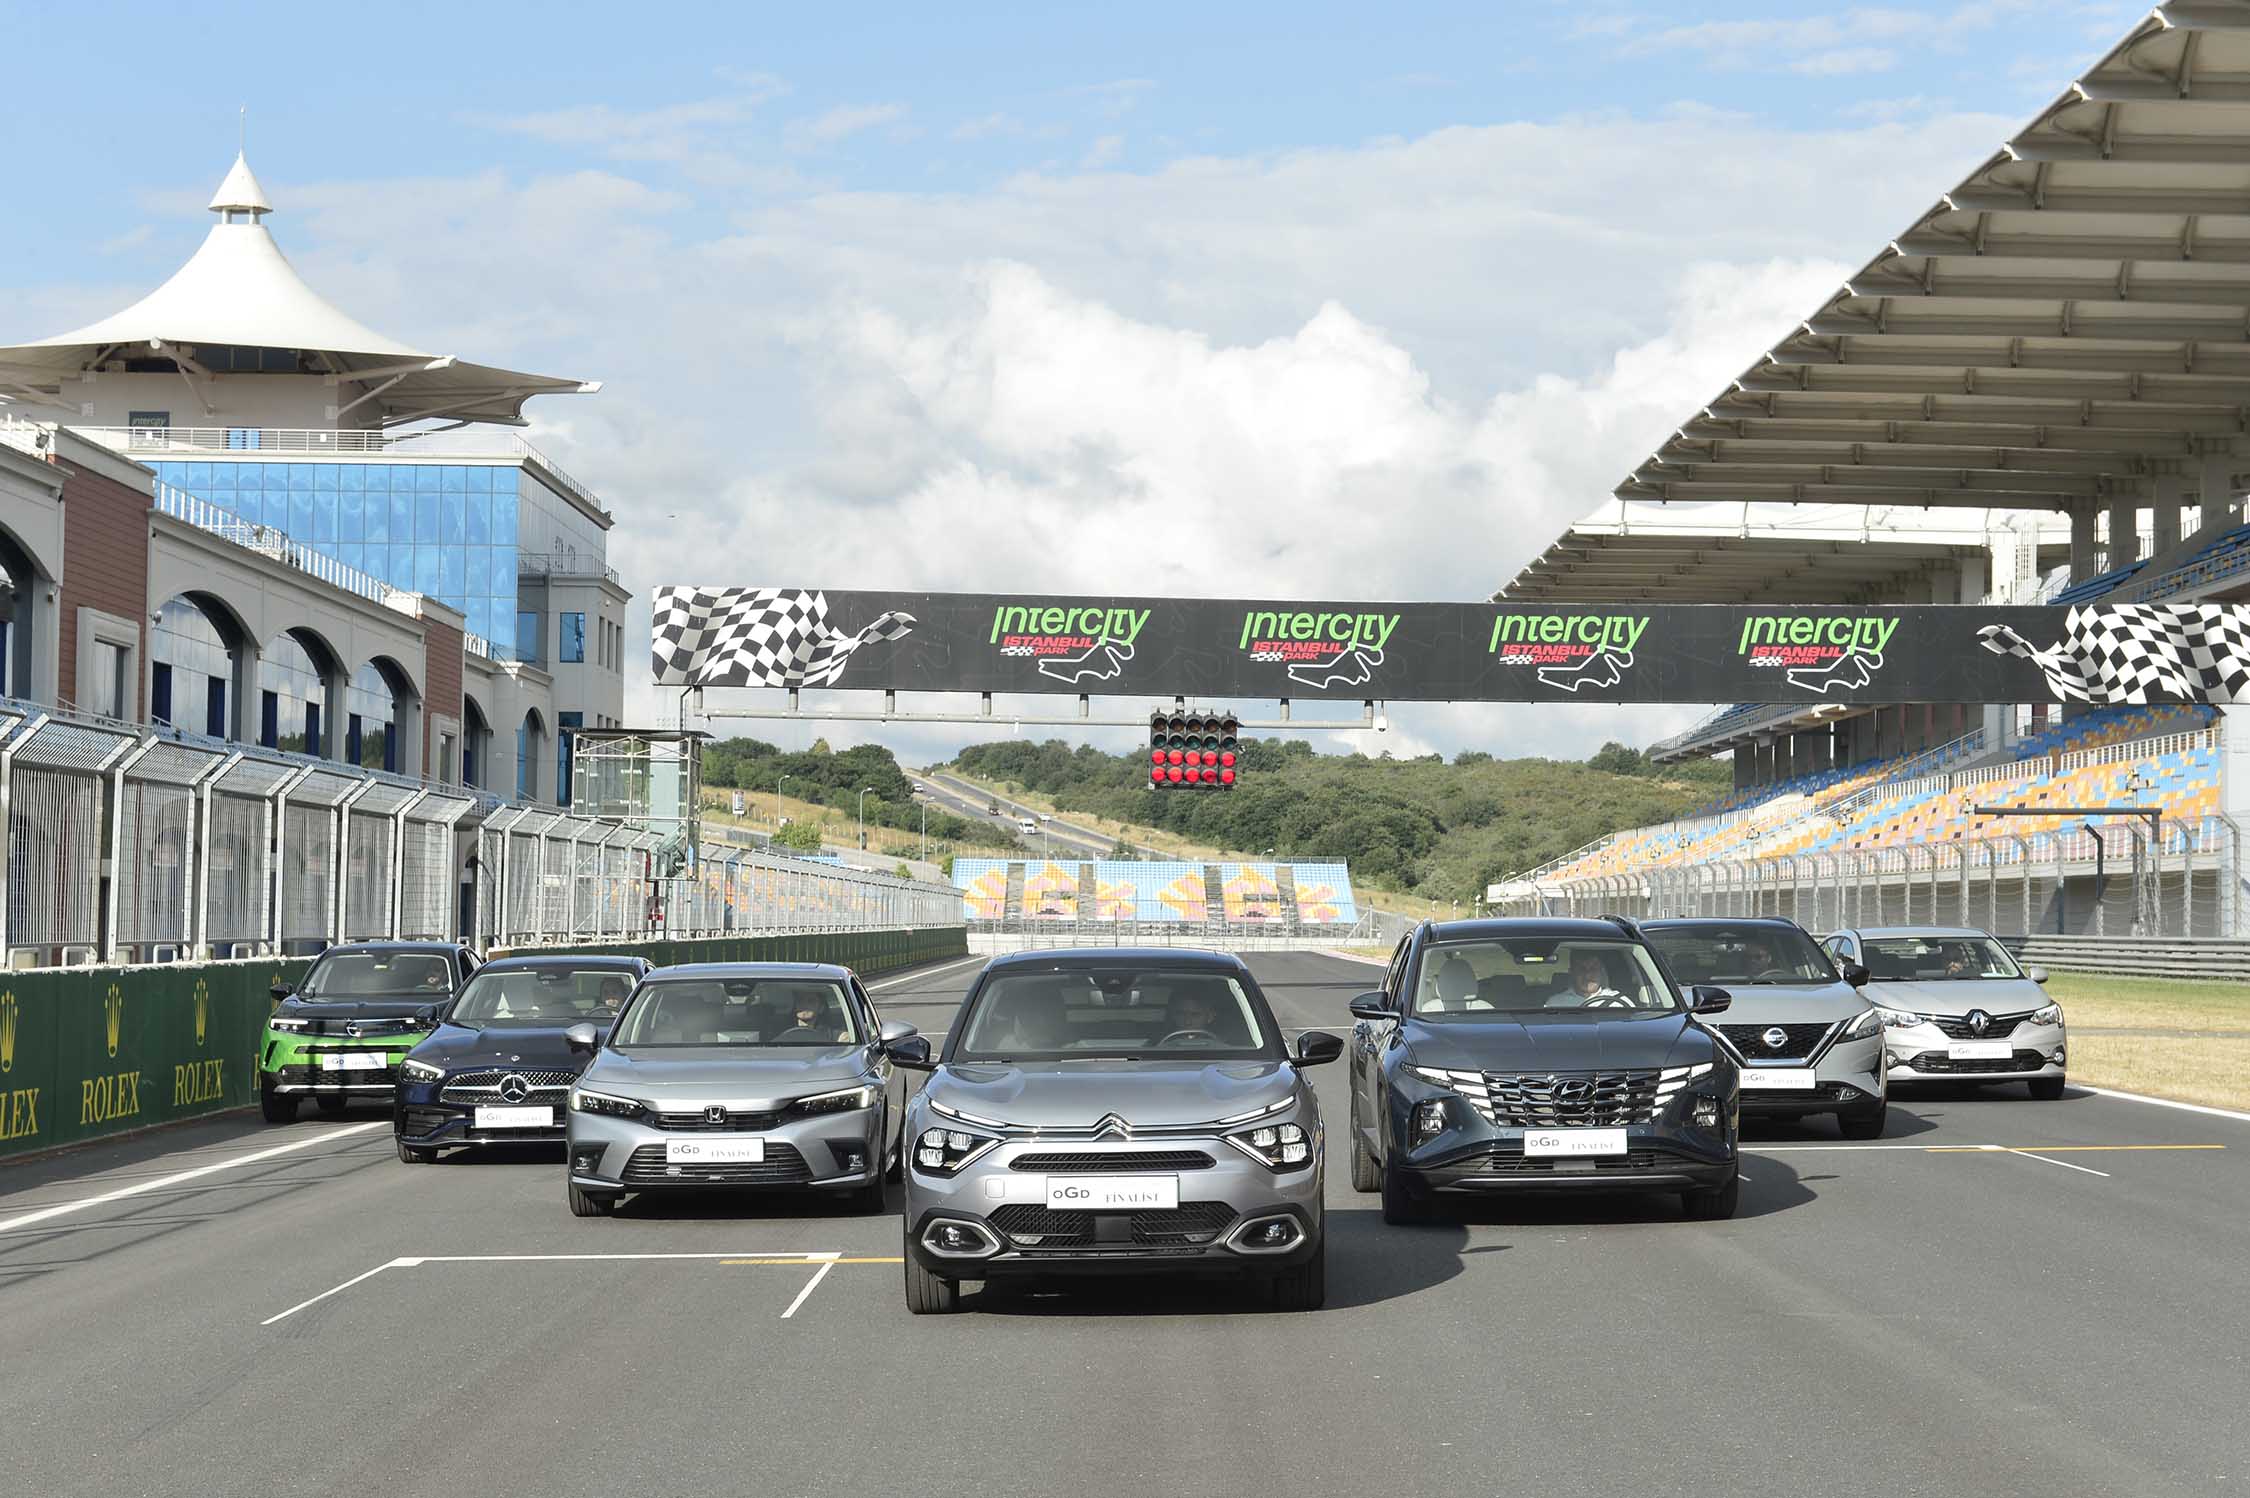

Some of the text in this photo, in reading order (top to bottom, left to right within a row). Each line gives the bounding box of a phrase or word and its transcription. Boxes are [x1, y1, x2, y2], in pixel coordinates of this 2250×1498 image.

[1003, 635, 1095, 648] ISTANBUL
[1252, 641, 1345, 653] ISTANBUL
[1502, 644, 1595, 656] ISTANBUL
[1751, 646, 1845, 657] ISTANBUL
[173, 1058, 225, 1107] ROLEX
[80, 1071, 141, 1125] ROLEX
[0, 1087, 40, 1140] LEX
